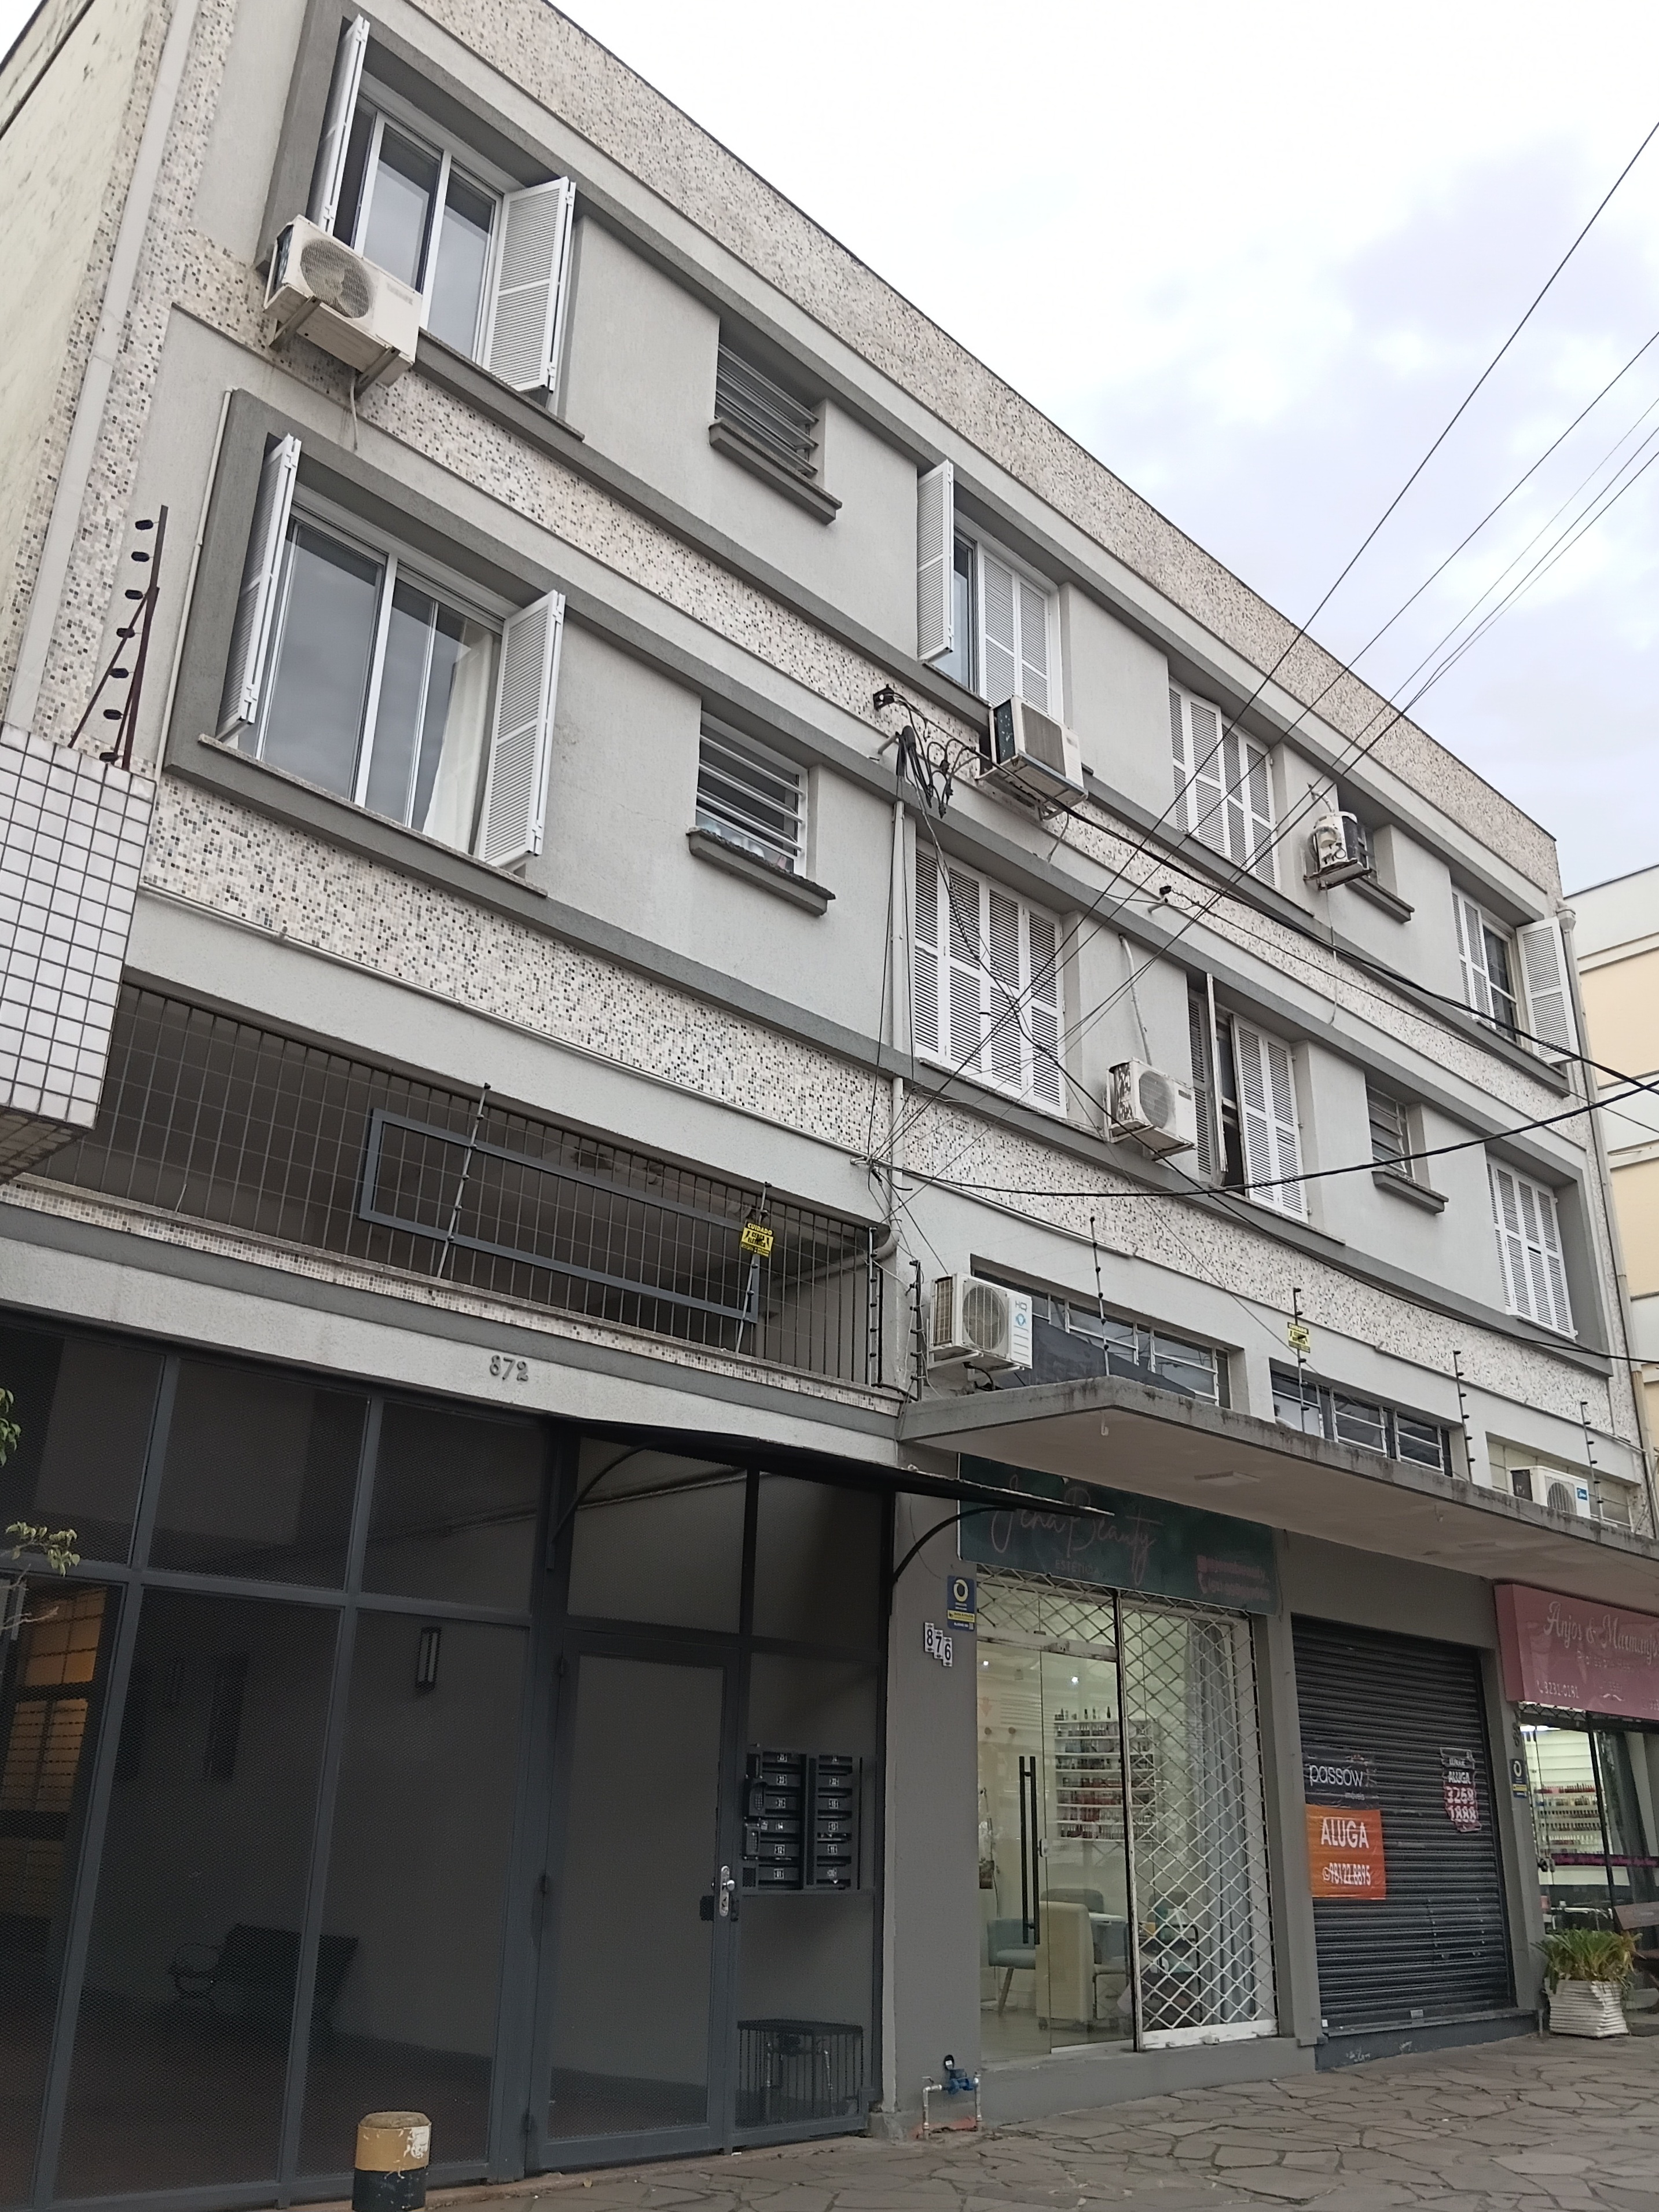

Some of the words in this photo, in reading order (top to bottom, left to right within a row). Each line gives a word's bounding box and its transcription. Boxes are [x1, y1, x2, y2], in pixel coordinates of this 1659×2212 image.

[747, 1223, 773, 1235] CUIDADO
[489, 1354, 529, 1382] 872
[926, 1628, 952, 1661] 876
[1543, 1601, 1583, 1649] Anjos
[1586, 1617, 1596, 1644] &
[1601, 1613, 1659, 1666] Marmanjo
[1309, 1764, 1364, 1787] passow
[1448, 1771, 1471, 1784] ALUGA
[1321, 1817, 1370, 1848] ALUGA
